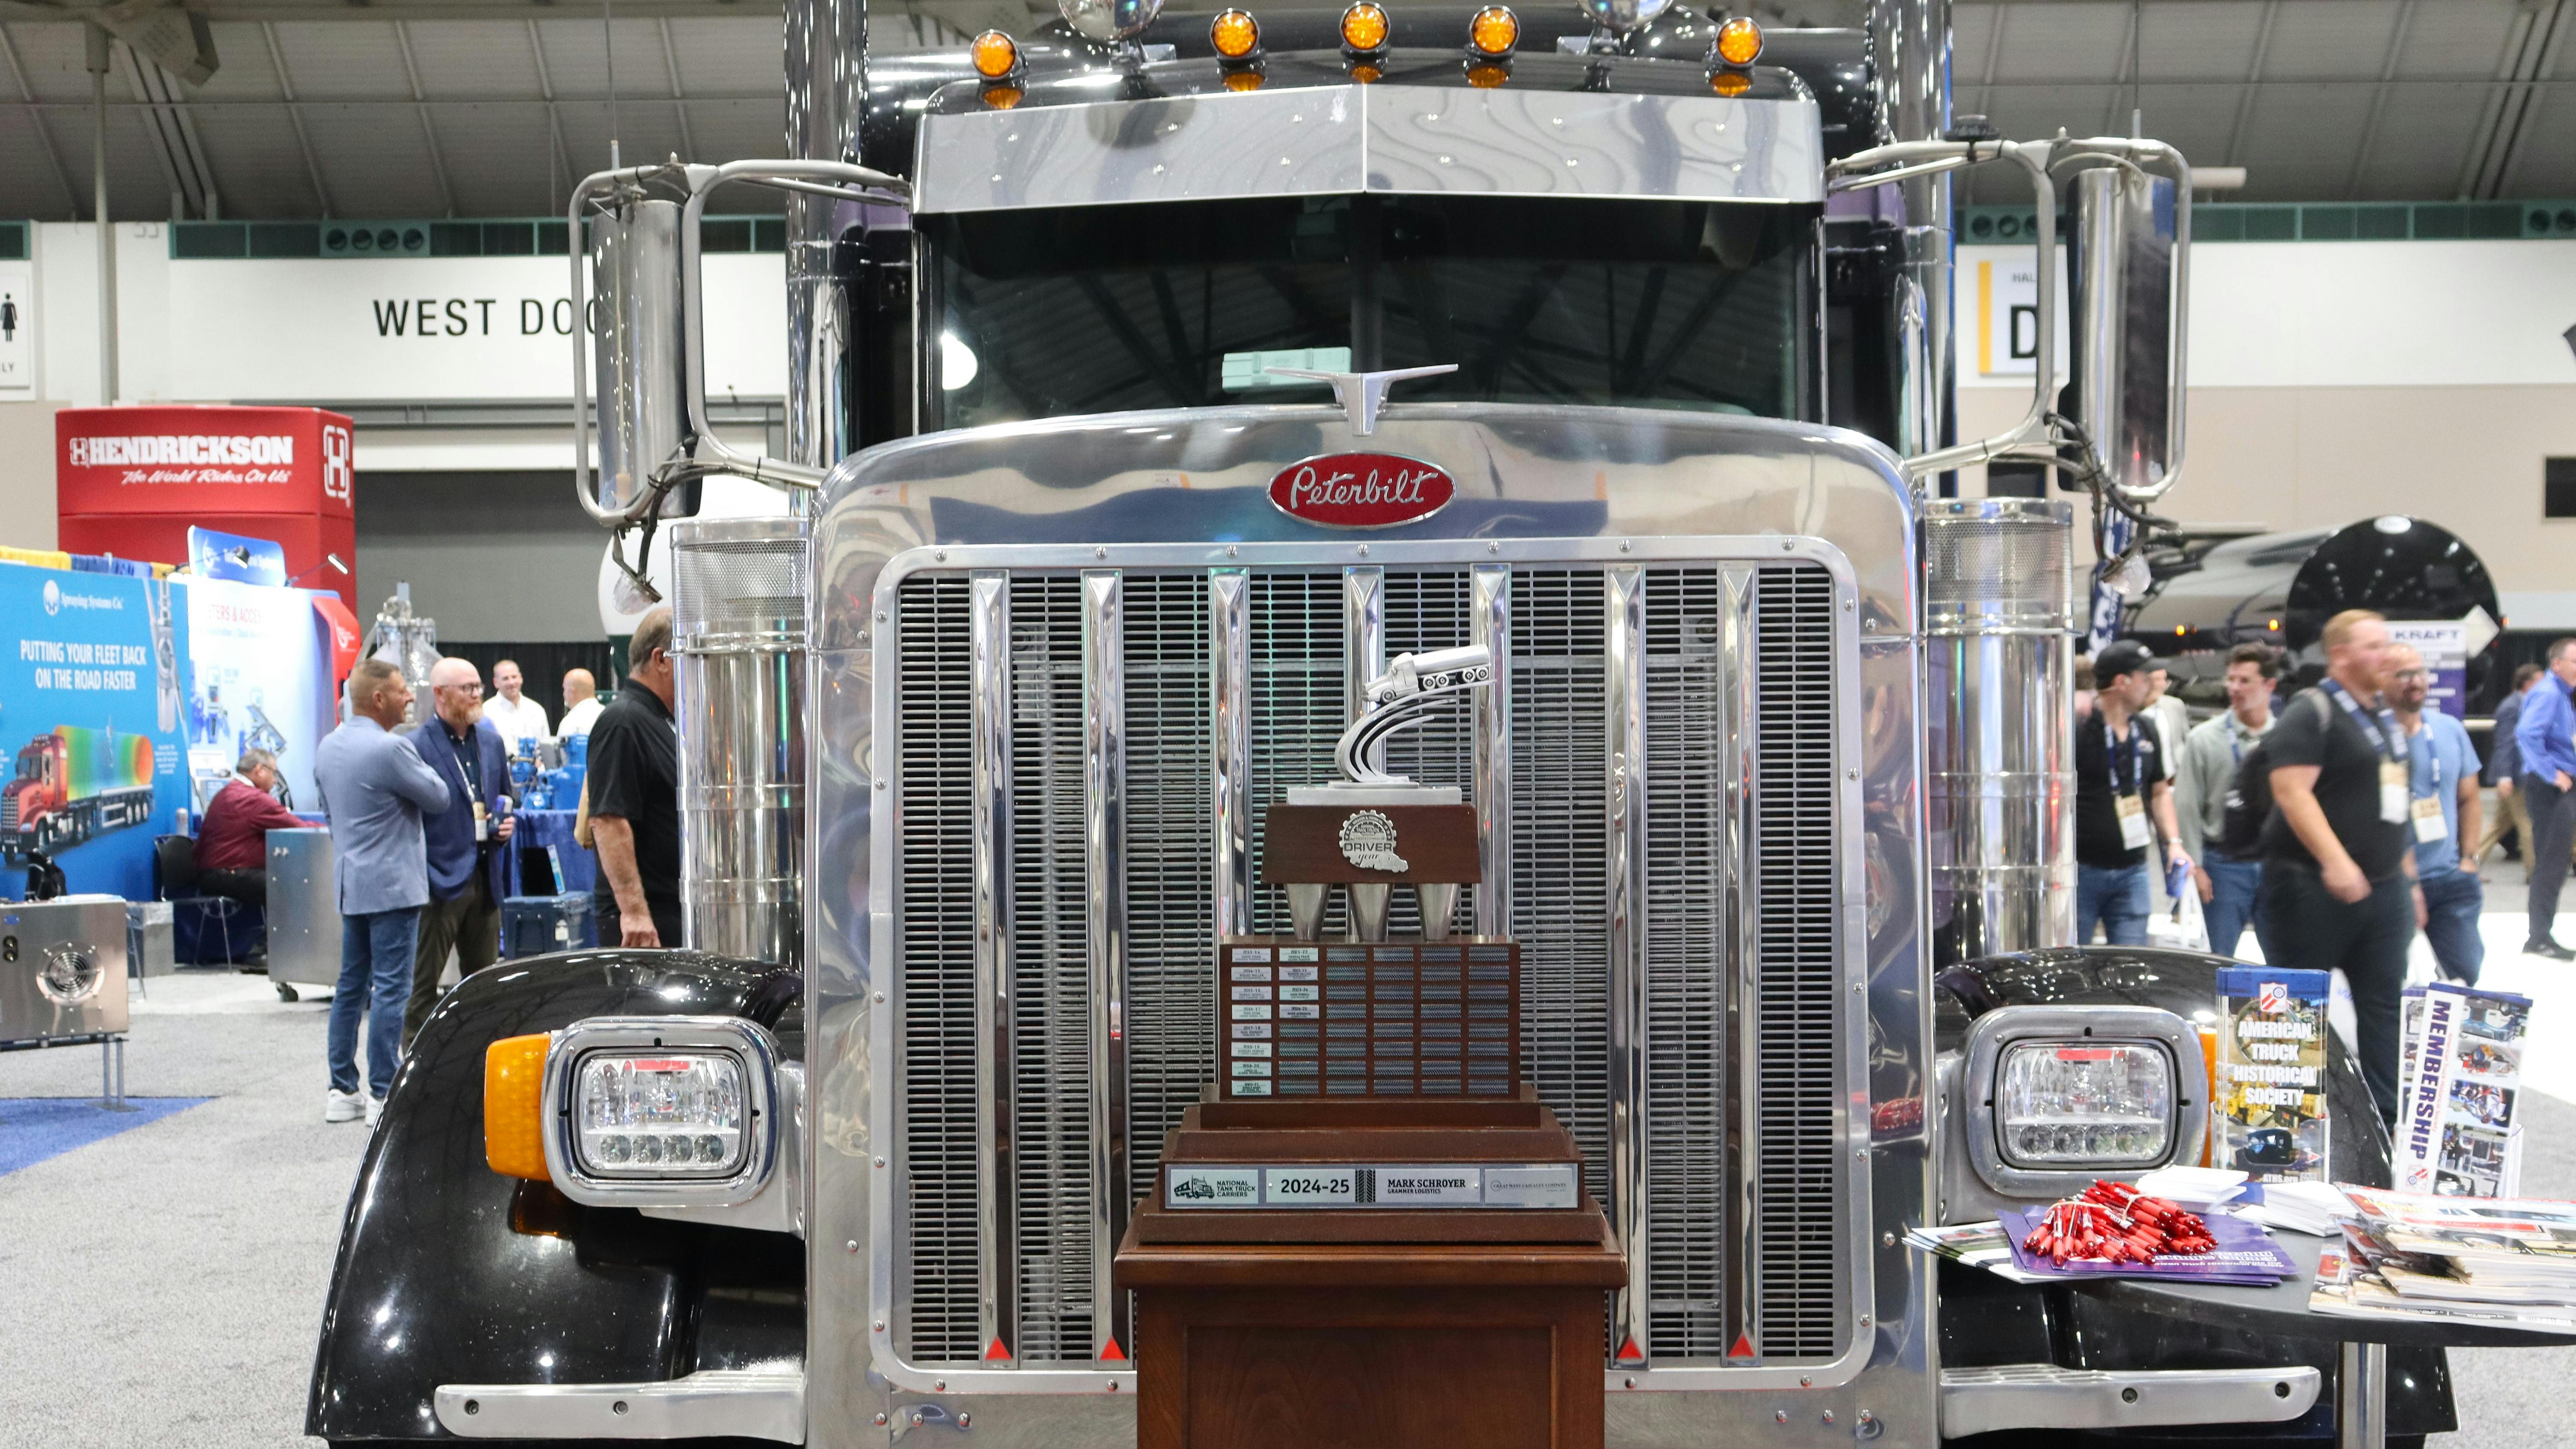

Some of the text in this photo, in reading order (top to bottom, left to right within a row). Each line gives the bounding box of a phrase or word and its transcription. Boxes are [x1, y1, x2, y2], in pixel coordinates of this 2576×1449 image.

[374, 299, 496, 336] WEST
[0, 361, 15, 372] LY
[89, 435, 293, 465] HENDRICKSON
[121, 468, 289, 485] The World Rides On Us
[1290, 465, 1438, 510] Peterbilt
[61, 592, 88, 610] Spraying
[88, 595, 112, 610] Systems
[2395, 629, 2460, 640] KRAFT
[20, 639, 147, 665] PUTTING YOUR FLEET BACK
[35, 668, 137, 690] ON THE ROAD FASTER
[1344, 843, 1392, 851] DRIVER
[2238, 1021, 2312, 1039] AMERICAN
[2251, 1043, 2300, 1061] TRUCK
[2234, 1065, 2318, 1086] HISTORICAL
[2410, 999, 2452, 1160] MEMBERSHIP
[2245, 1088, 2305, 1106] SOCIETY
[1281, 1179, 1350, 1194] 2024-25
[1388, 1179, 1466, 1188] MARK SCHROYER
